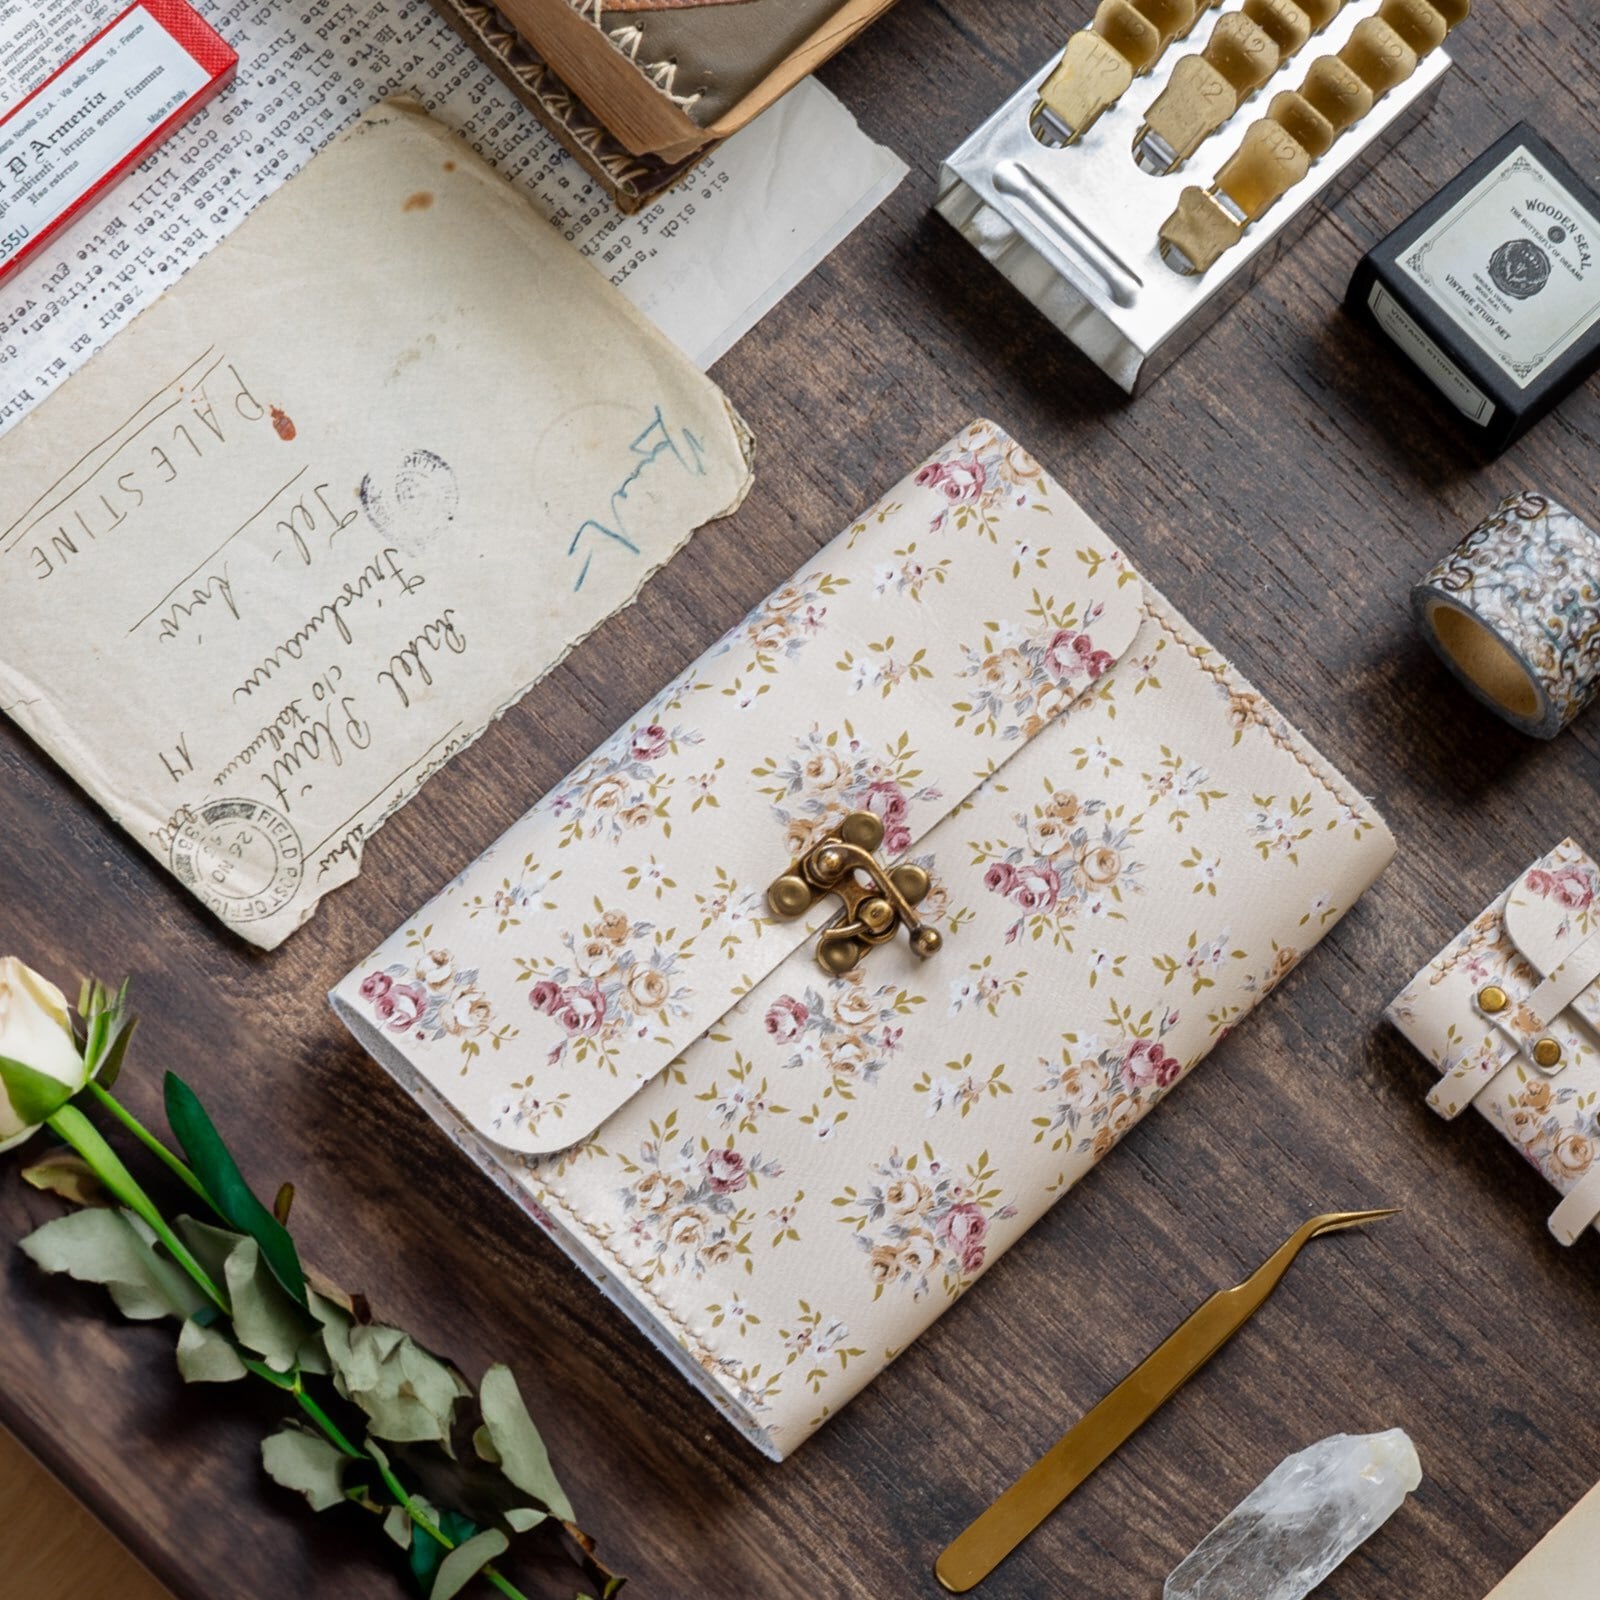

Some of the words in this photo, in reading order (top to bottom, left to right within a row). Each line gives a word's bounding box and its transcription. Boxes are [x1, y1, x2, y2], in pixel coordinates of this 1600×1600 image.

[53, 13, 83, 38] Planta
[315, 2, 359, 41] Kind
[339, 1, 390, 45] hatte
[6, 34, 55, 80] ornamental
[59, 87, 74, 98] Via
[119, 24, 145, 46] Firenze
[210, 27, 302, 104] furchtbar
[257, 36, 318, 88] hatte,
[305, 48, 336, 78] all
[368, 51, 392, 74] da
[336, 77, 366, 106] sie
[368, 54, 425, 105] verbot
[221, 98, 254, 126] was
[244, 66, 350, 158] aufbrachte,
[255, 80, 304, 124] diese
[10, 159, 56, 203] ambienti
[59, 126, 97, 157] brucia
[96, 99, 126, 127] senza
[123, 65, 166, 100] fiamma
[126, 103, 210, 177] gelitten.
[179, 129, 219, 165] doch
[293, 107, 339, 145] mich
[48, 160, 80, 188] esterno
[133, 129, 253, 235] Grausamkeiten
[253, 148, 289, 185] sehr
[700, 170, 730, 200] sie
[128, 167, 180, 214] Lilli
[193, 167, 242, 210] weiss
[209, 188, 251, 224] lieb
[76, 216, 128, 261] hätte
[158, 213, 191, 242] ich
[636, 203, 665, 235] auf
[659, 203, 696, 239] sich
[1525, 198, 1578, 235] WOODEN
[1573, 233, 1593, 271] SEAL
[107, 239, 131, 260] zu
[148, 227, 209, 276] hatte,
[601, 235, 632, 264] dem
[1509, 206, 1523, 220] THE
[1520, 217, 1555, 250] BUTTERFLY
[1551, 248, 1561, 258] OF
[1559, 257, 1584, 282] DREAMS
[41, 261, 71, 294] gut
[82, 245, 156, 310] nicht...
[21, 264, 104, 336] ertragen,
[1444, 273, 1476, 306] VINTAGE
[1473, 303, 1500, 327] STUDY
[1494, 325, 1512, 341] SET
[69, 333, 92, 354] an
[35, 357, 67, 387] mit
[31, 363, 266, 580] PALESTINE
[257, 809, 299, 859] FIELD
[269, 866, 299, 907] POST
